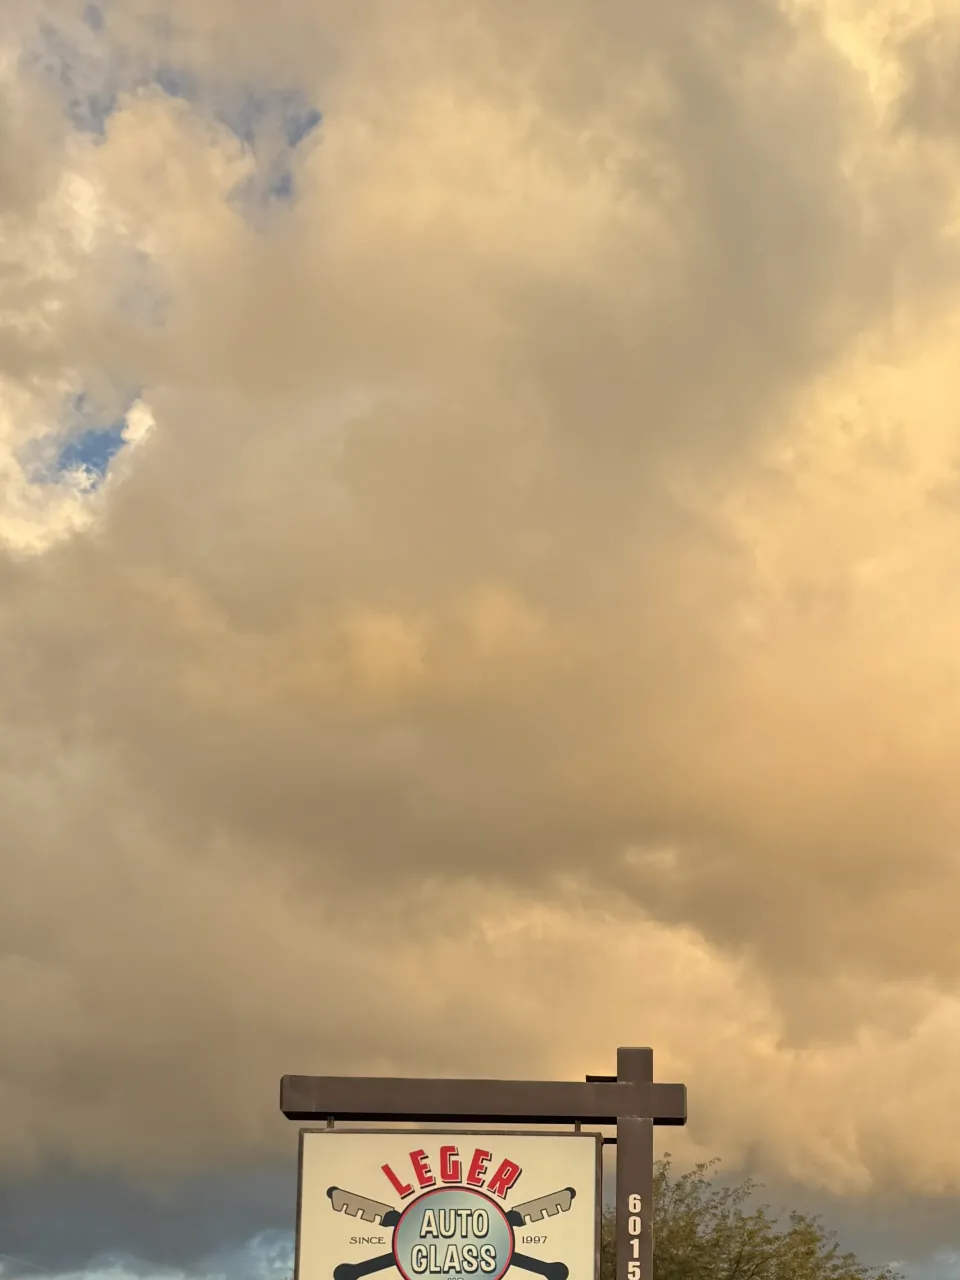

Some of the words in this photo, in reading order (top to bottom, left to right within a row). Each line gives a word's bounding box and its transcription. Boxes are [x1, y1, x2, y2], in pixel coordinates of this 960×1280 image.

[381, 1145, 522, 1199] LEGER
[419, 1208, 490, 1238] AUTO
[349, 1235, 386, 1245] SINCE
[521, 1234, 548, 1245] 1997
[410, 1244, 497, 1274] GLASS
